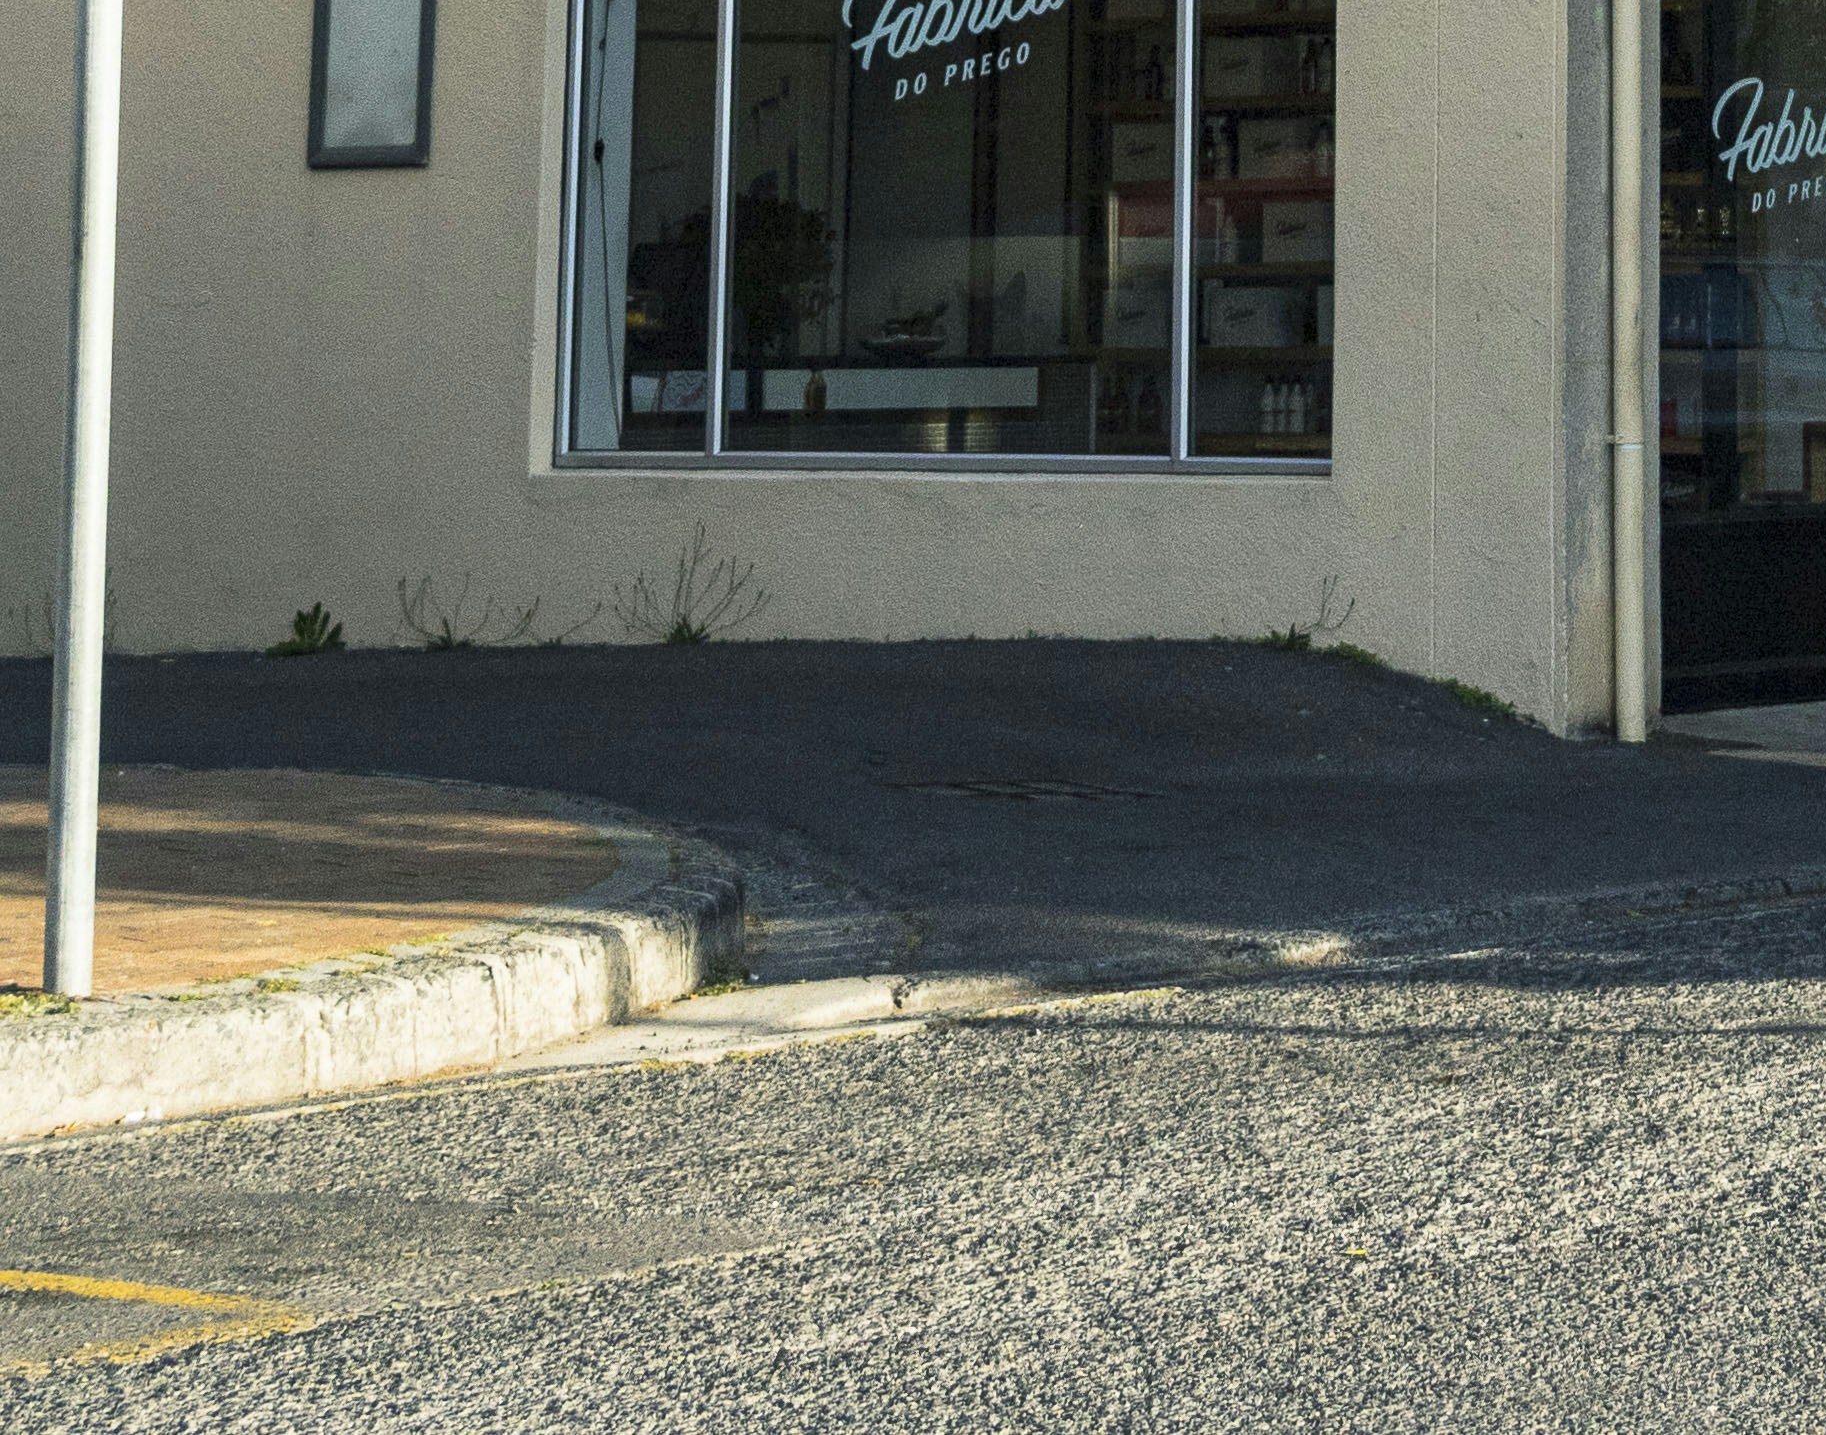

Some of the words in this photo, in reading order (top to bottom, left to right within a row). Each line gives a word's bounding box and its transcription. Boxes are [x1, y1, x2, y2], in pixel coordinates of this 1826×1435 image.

[894, 71, 928, 102] DO
[944, 40, 1032, 87] PREGO
[1751, 187, 1776, 214] DO
